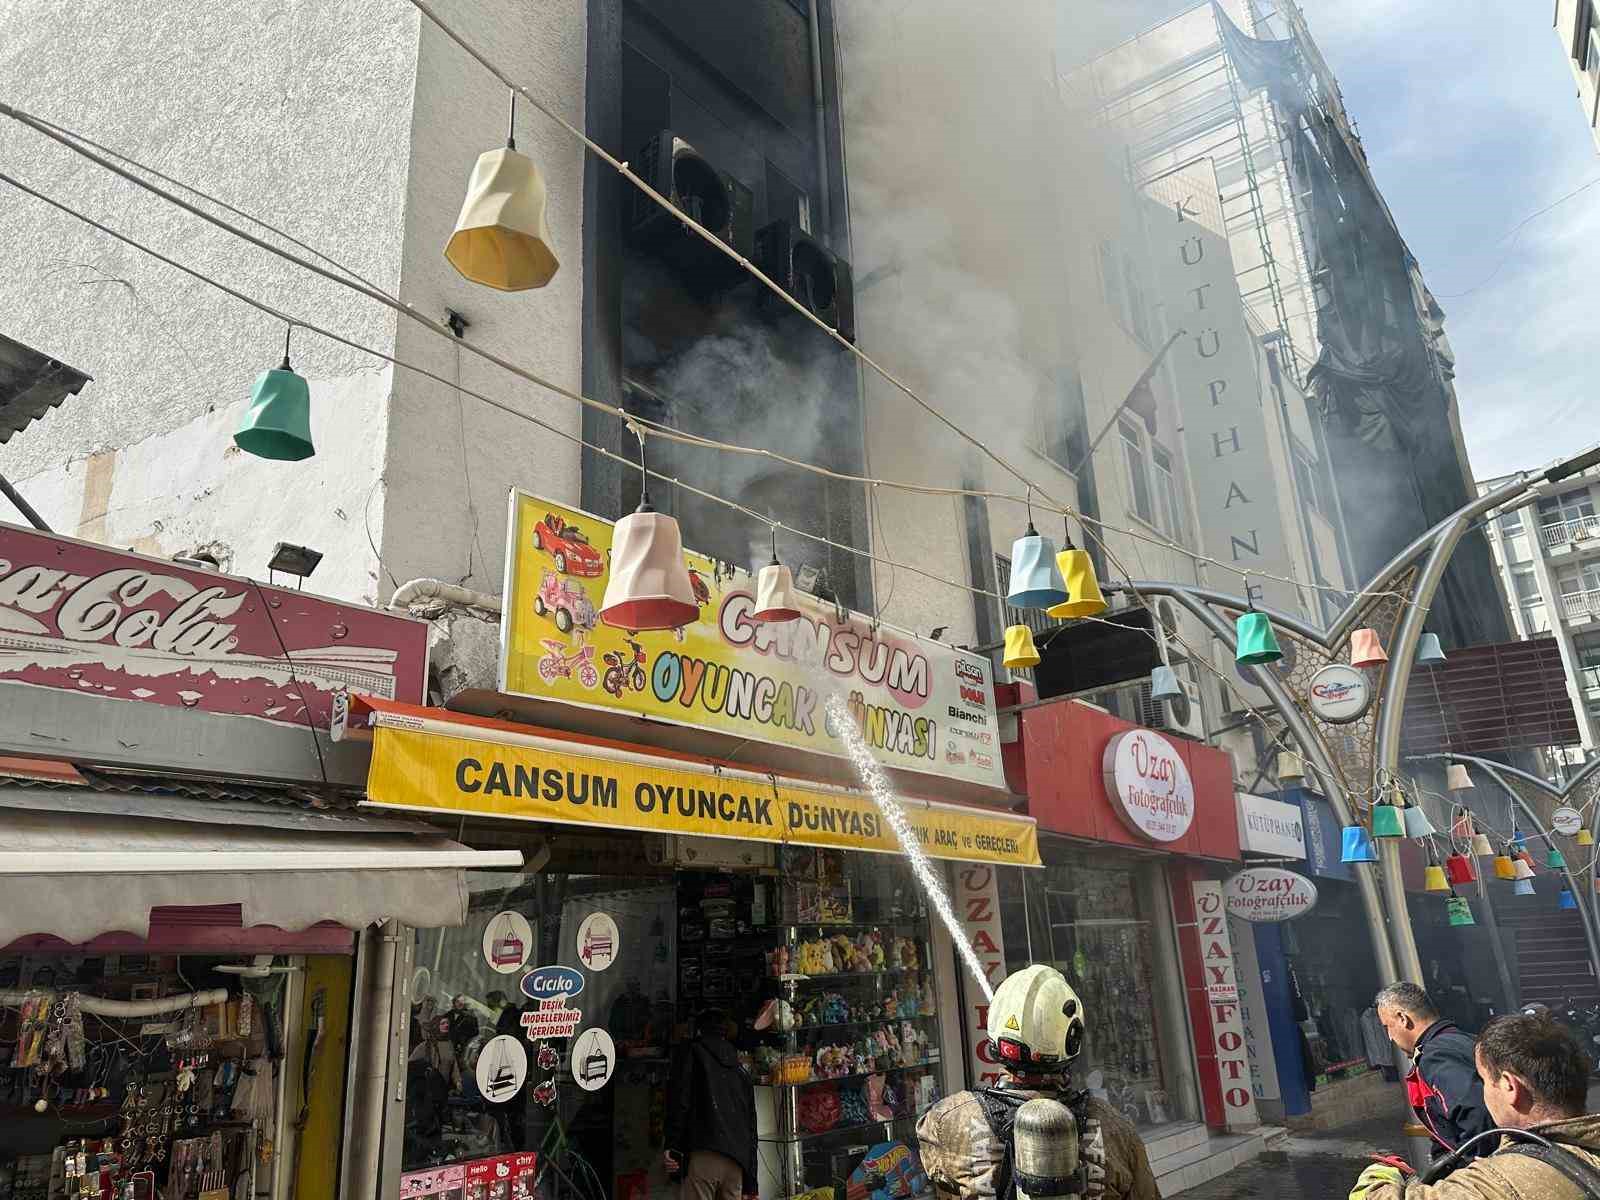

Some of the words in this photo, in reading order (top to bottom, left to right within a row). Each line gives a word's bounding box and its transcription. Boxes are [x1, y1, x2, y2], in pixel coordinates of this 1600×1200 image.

[57, 567, 247, 656] Cola
[652, 650, 816, 736] OYUNCAK
[948, 706, 987, 726] Bianchi
[456, 758, 618, 809] CANSUM
[635, 781, 773, 826] OYUNCAK
[788, 800, 881, 838] DÜNYASI
[934, 826, 958, 850] ARAÇ
[963, 836, 972, 848] ve
[1131, 735, 1176, 795] Üzay
[1235, 874, 1296, 897] Üzay
[1198, 892, 1236, 985] ÜZAY
[1213, 1003, 1250, 1108] FOTO
